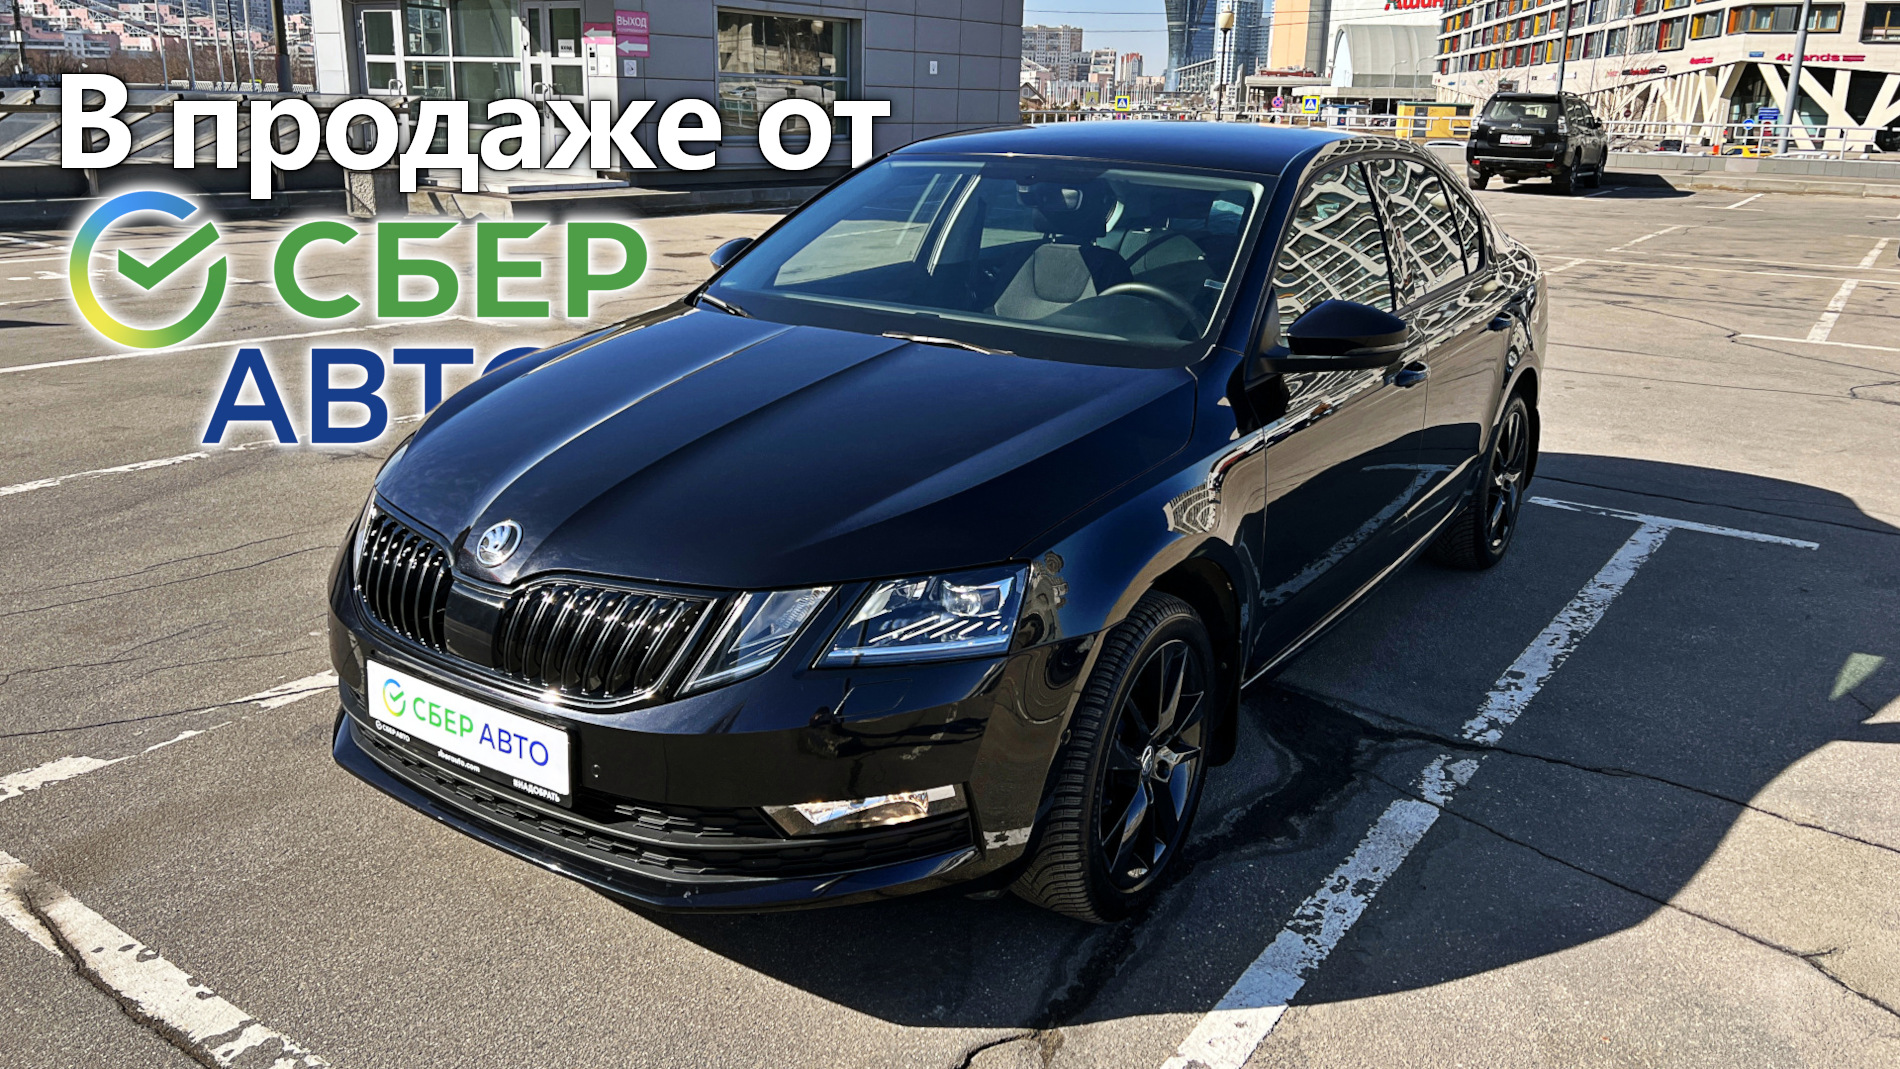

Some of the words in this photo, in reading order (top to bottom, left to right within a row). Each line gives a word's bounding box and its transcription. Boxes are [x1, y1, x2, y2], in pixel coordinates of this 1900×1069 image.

[616, 16, 648, 28] ВЫХОД
[413, 697, 474, 738] СБЕР
[479, 723, 549, 767] АВТО
